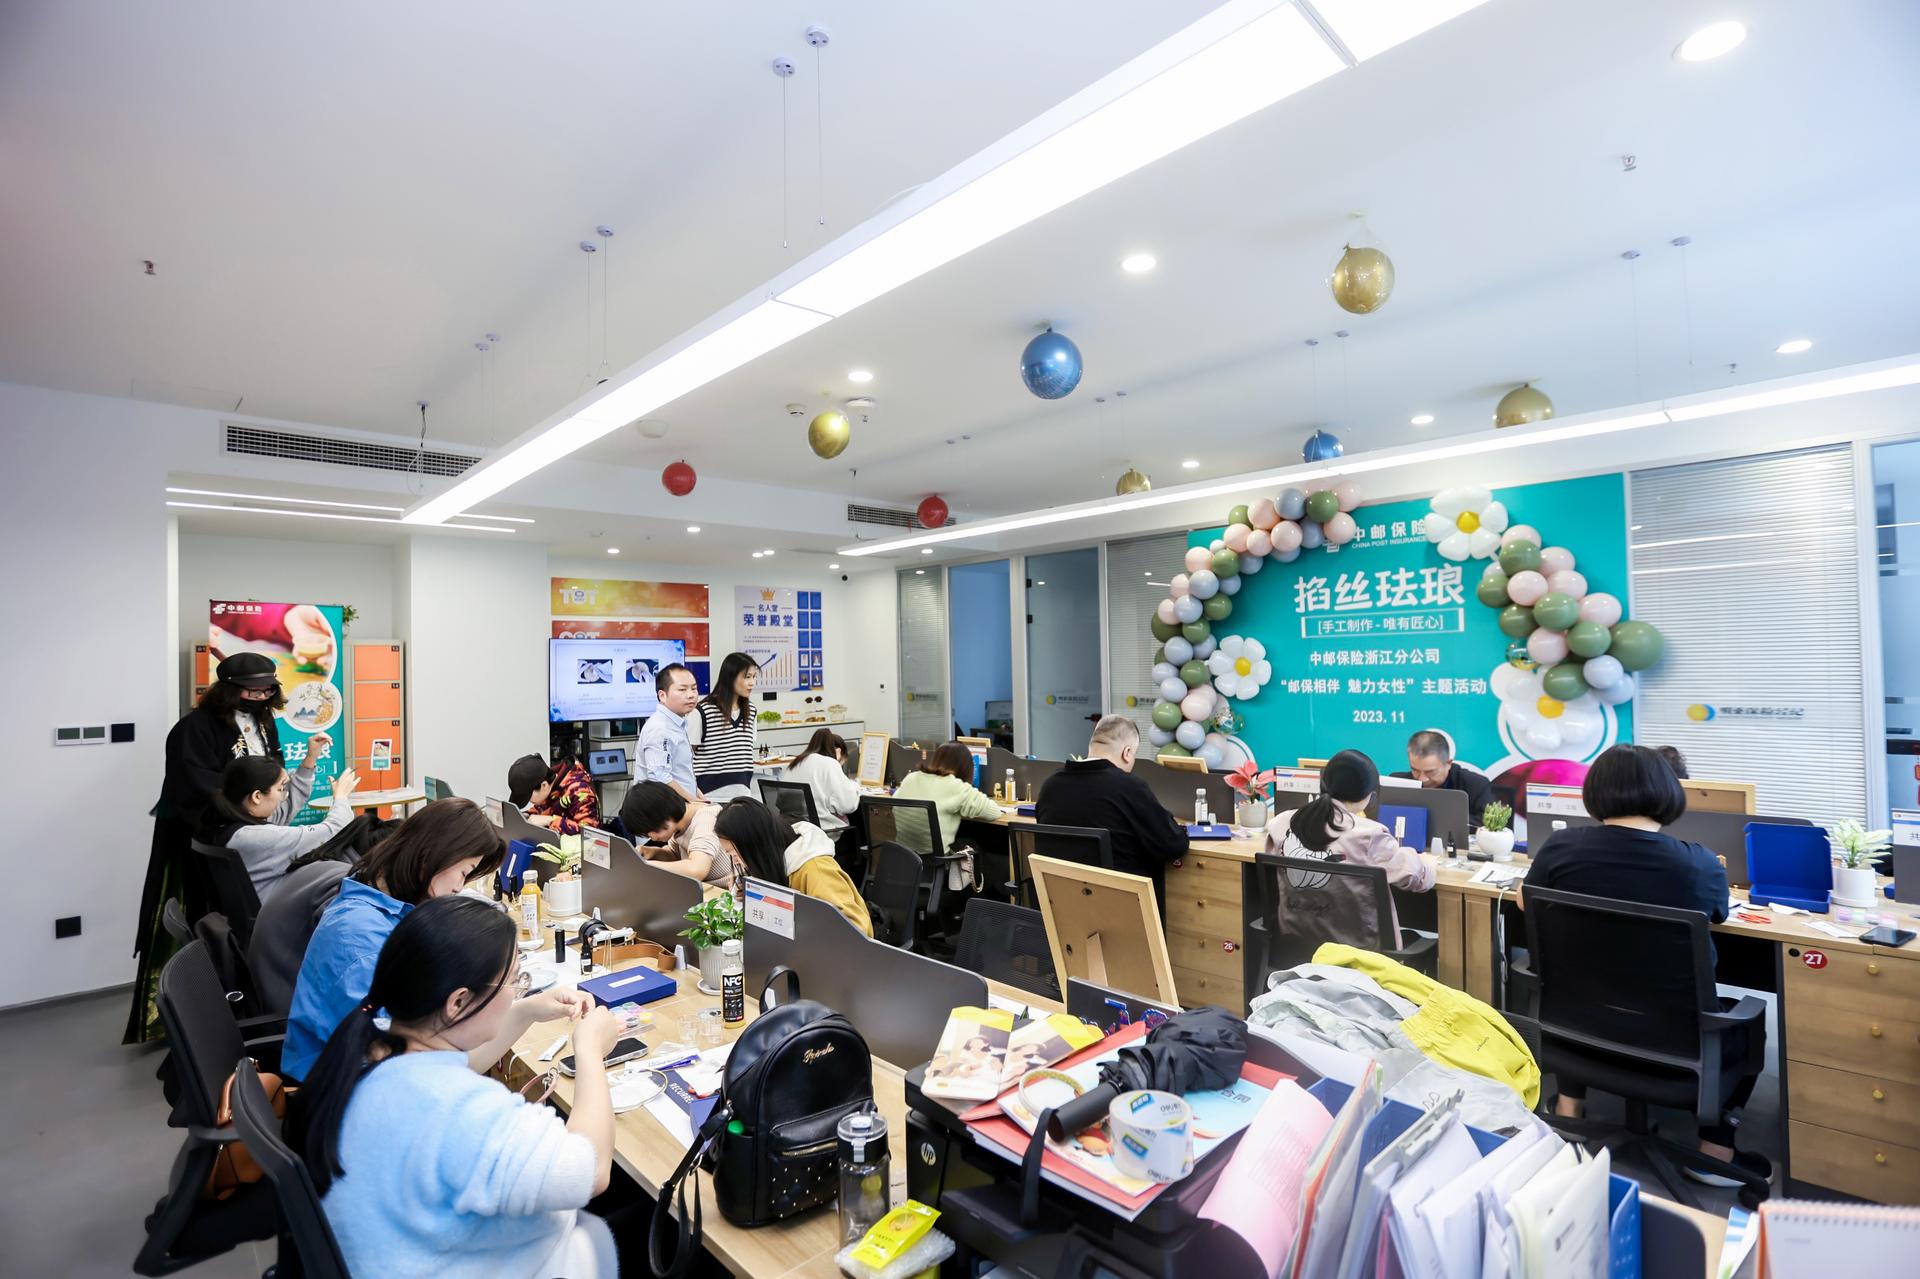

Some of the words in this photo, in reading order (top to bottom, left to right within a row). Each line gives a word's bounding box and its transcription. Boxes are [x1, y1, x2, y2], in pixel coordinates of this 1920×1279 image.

[1353, 519, 1427, 541] 中邮保险
[1294, 563, 1465, 613] 掐丝珐琅
[758, 604, 778, 612] 名人堂
[743, 613, 793, 627] 荣誉殿堂
[1310, 648, 1441, 666] 中邮保险浙江分公司
[1422, 679, 1487, 695] 主题活动
[752, 907, 765, 921] 共享
[1223, 941, 1233, 951] 26
[1804, 954, 1823, 965] 27
[724, 975, 742, 987] NFC
